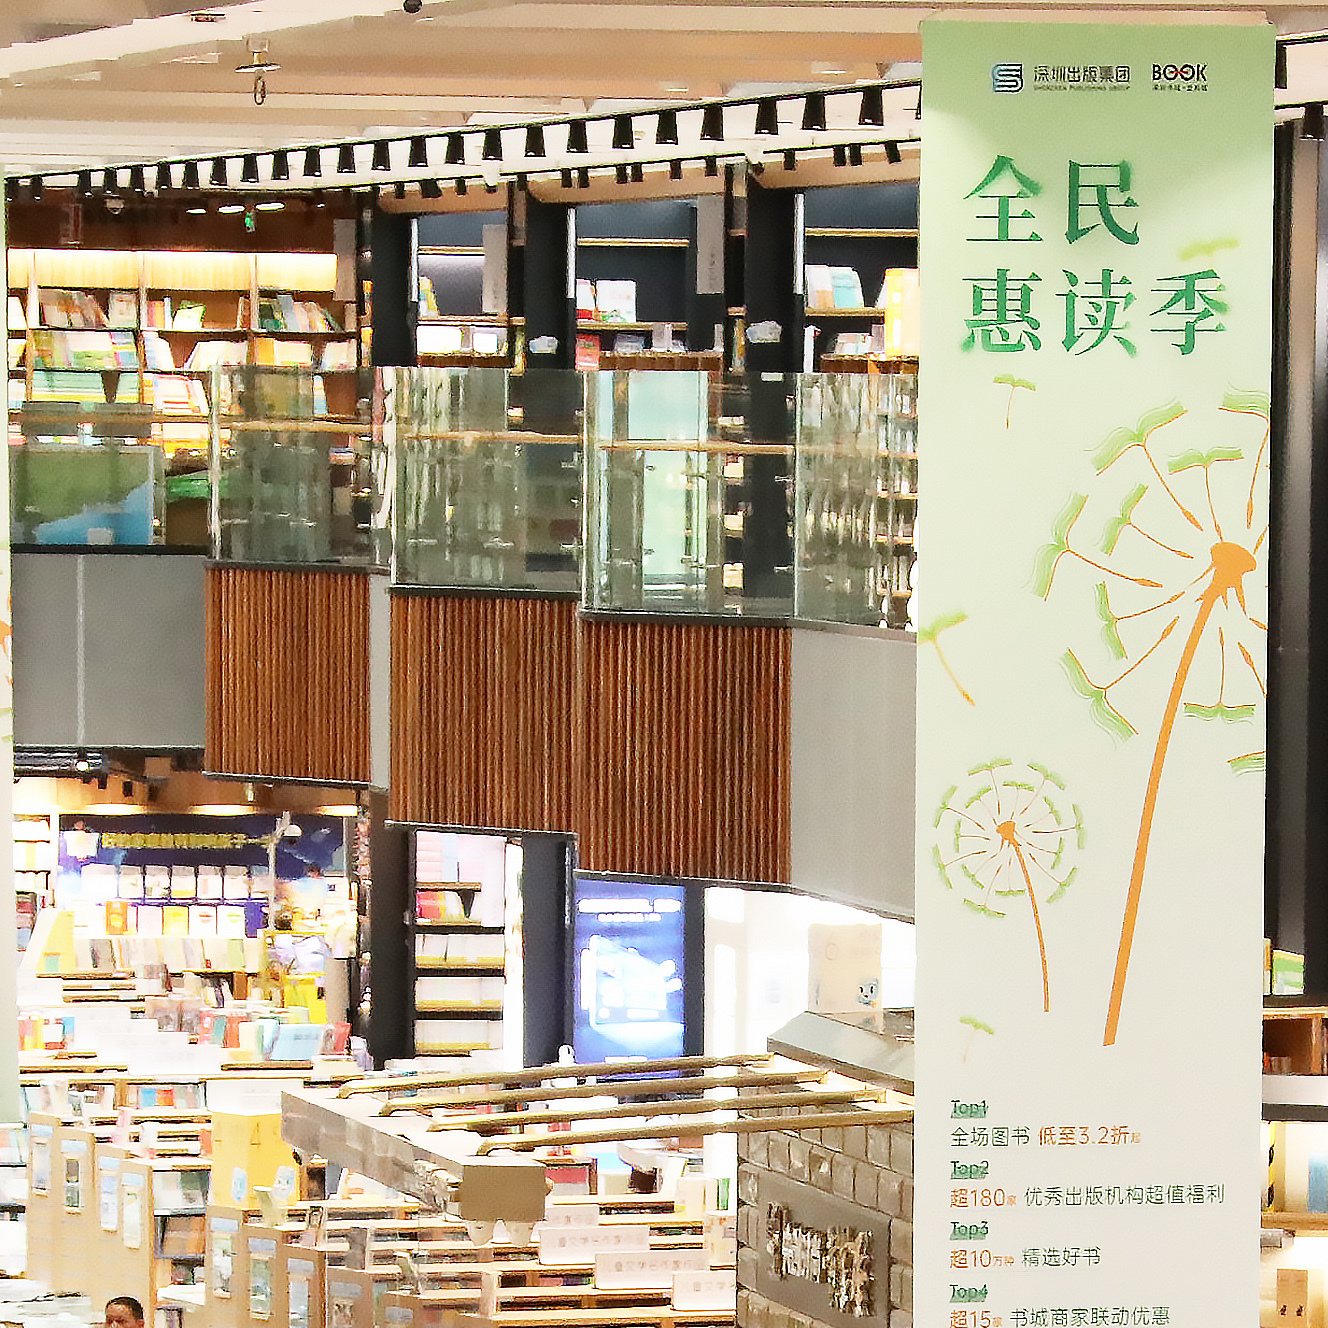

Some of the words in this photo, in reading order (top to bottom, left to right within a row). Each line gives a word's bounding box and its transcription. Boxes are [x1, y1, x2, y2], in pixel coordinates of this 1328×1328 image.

[1034, 65, 1130, 83] 深圳出版集团
[1152, 63, 1208, 82] BOOK
[963, 155, 1140, 246] 全民
[961, 269, 1230, 356] 惠读季
[950, 1100, 988, 1118] Top1
[950, 1126, 1030, 1147] 全场图书
[950, 1161, 989, 1179] Top2
[1024, 1184, 1225, 1207] 优秀出版机构超值福利
[950, 1221, 989, 1240] Top3
[1022, 1247, 1101, 1267] 精选好书
[949, 1284, 988, 1303] Top4
[1010, 1307, 1170, 1327] 书城商家联动优惠
